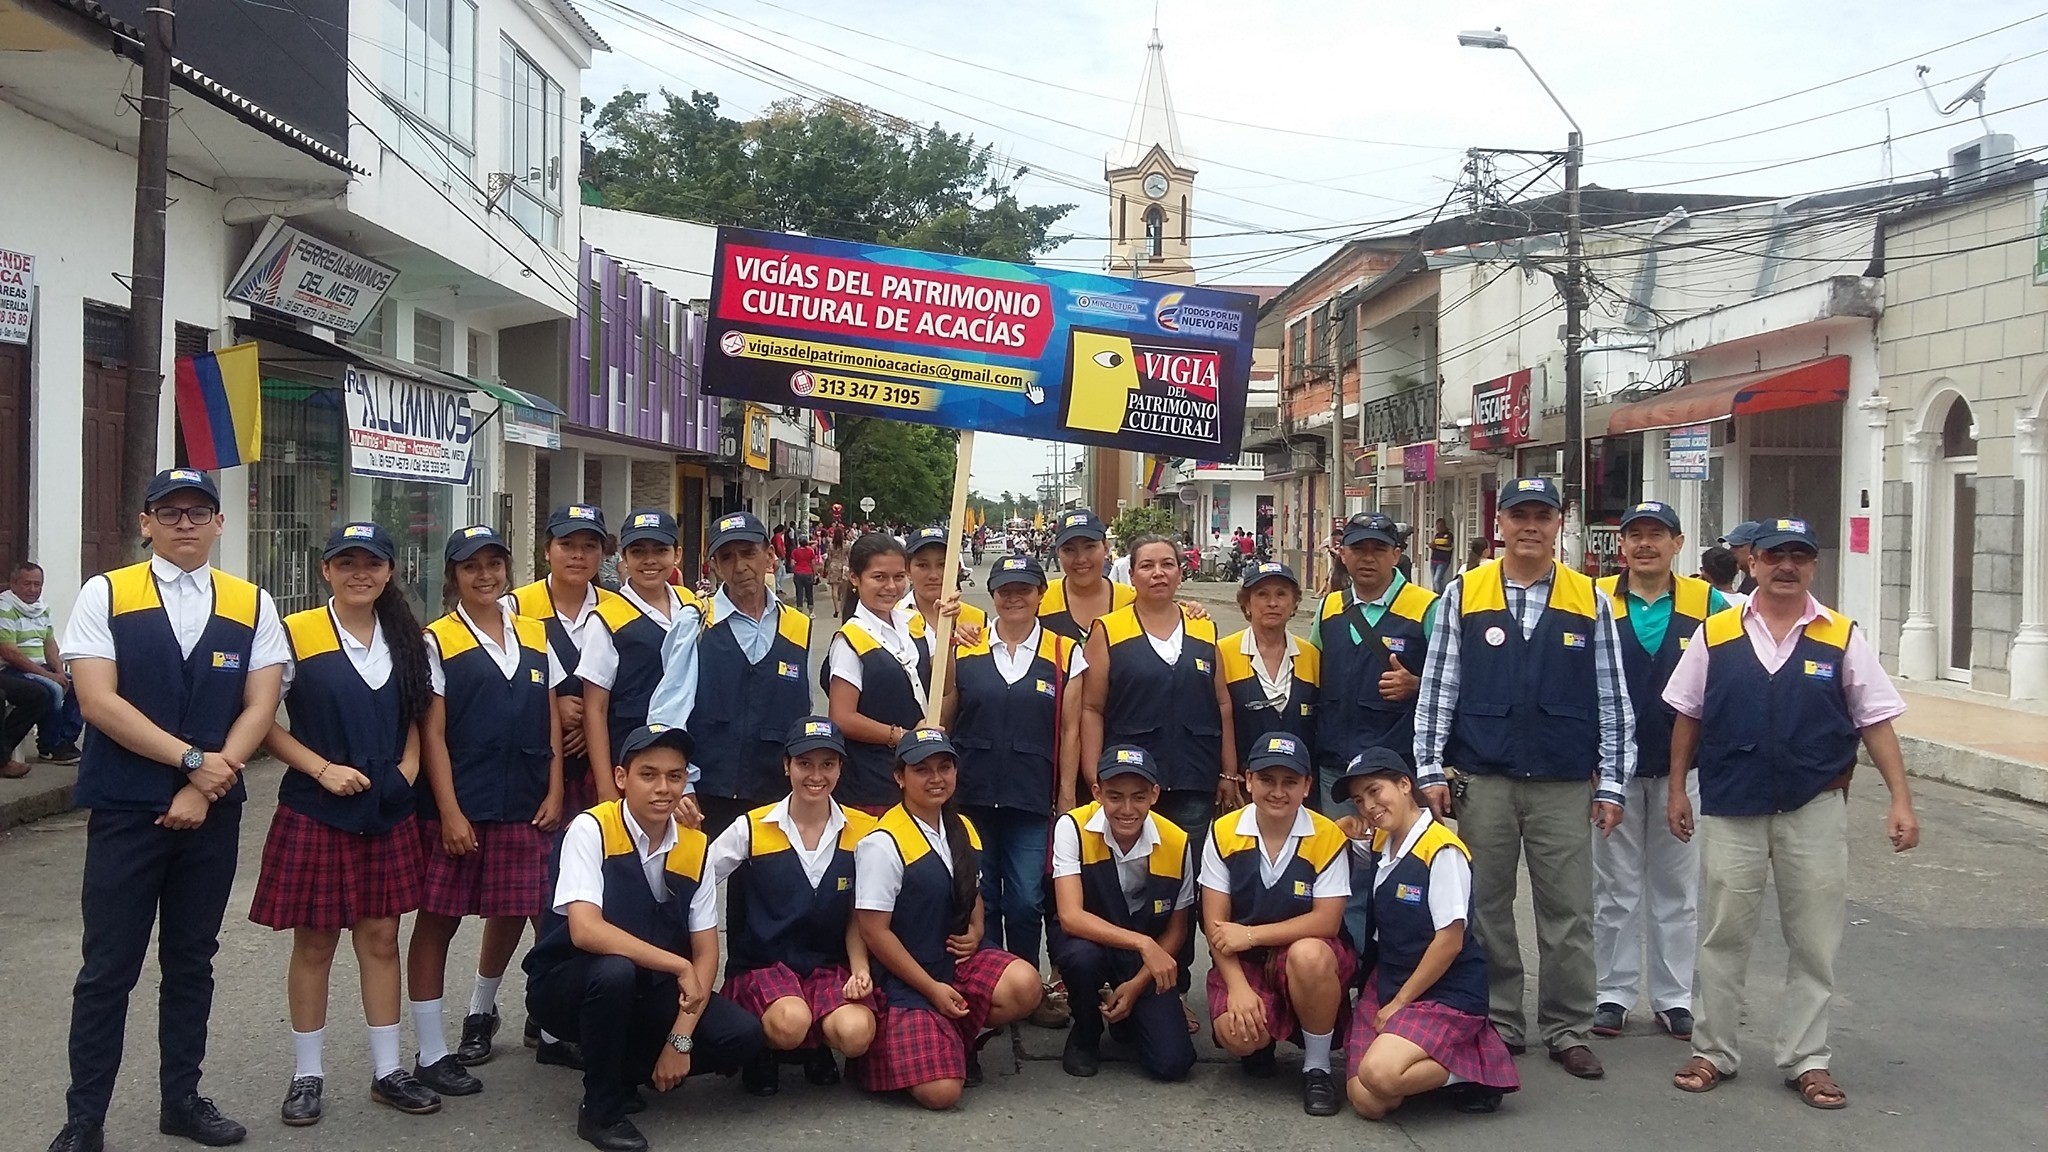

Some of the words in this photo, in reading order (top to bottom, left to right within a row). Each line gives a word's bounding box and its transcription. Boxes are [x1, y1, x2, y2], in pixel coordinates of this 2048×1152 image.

[0, 251, 31, 272] NDE
[291, 239, 391, 291] FERREALUMINIOS
[251, 287, 268, 302] FM
[298, 271, 324, 297] DEL
[324, 281, 359, 307] META
[735, 254, 819, 289] VIGÍAS
[827, 268, 874, 297] DEL
[881, 275, 1041, 318] PATRIMONIO
[742, 289, 868, 327] CULTURAL
[875, 305, 910, 333] DE
[915, 312, 1026, 347] ACACÍAS
[1091, 299, 1138, 313] MINCULTURA
[1183, 306, 1210, 317] TODOS
[1211, 310, 1227, 319] POR
[1228, 313, 1240, 321] UN
[1181, 316, 1215, 329] NUEVO
[1216, 319, 1239, 332] PAÍS
[749, 340, 1022, 386] vigiasdelpatrimonioacacias@gmail.com
[1144, 352, 1218, 388] VIGIA
[819, 378, 845, 396] 313
[849, 382, 878, 400] 347
[883, 386, 920, 405] 3195
[1167, 386, 1187, 398] DEL
[360, 374, 472, 444] ALUMINIOS
[1128, 393, 1217, 420] PATRIMONIO
[1129, 411, 1214, 438] CULTURAL
[1585, 525, 1622, 555] NESCAF
